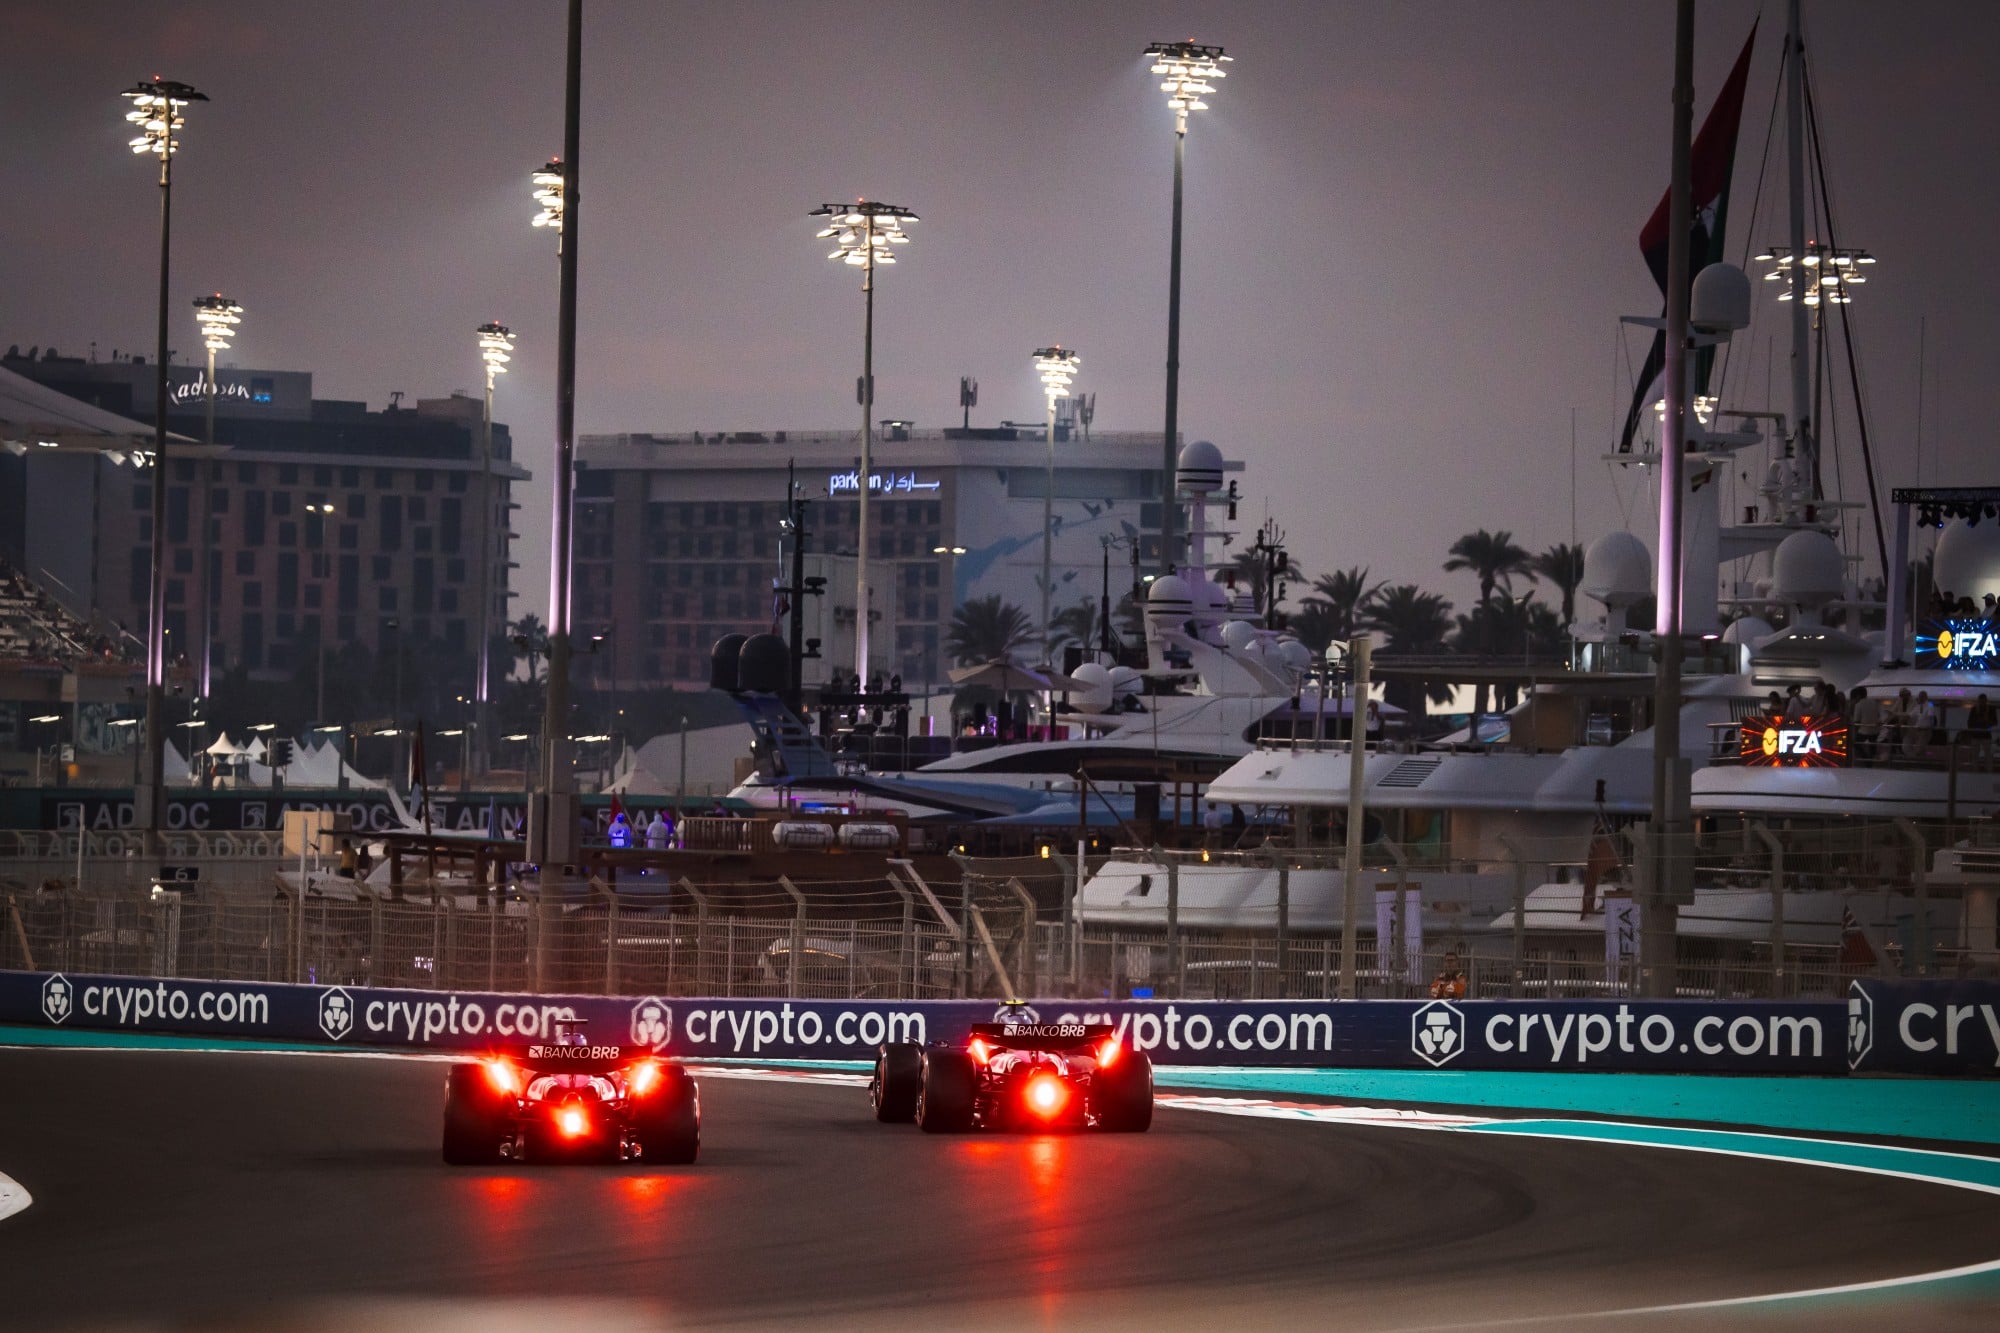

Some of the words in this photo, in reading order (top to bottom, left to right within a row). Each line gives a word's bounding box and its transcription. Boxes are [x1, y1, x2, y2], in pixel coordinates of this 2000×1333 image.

[829, 471, 859, 496] park
[1954, 633, 1997, 657] IFZA
[1778, 730, 1822, 754] IFZA
[92, 802, 210, 830] ADOC
[175, 868, 188, 881] 6
[83, 982, 268, 1024] crypto.com
[366, 996, 576, 1046] crypto.com
[685, 1003, 926, 1053] crypto.com
[1485, 1004, 1823, 1062] crypto.com
